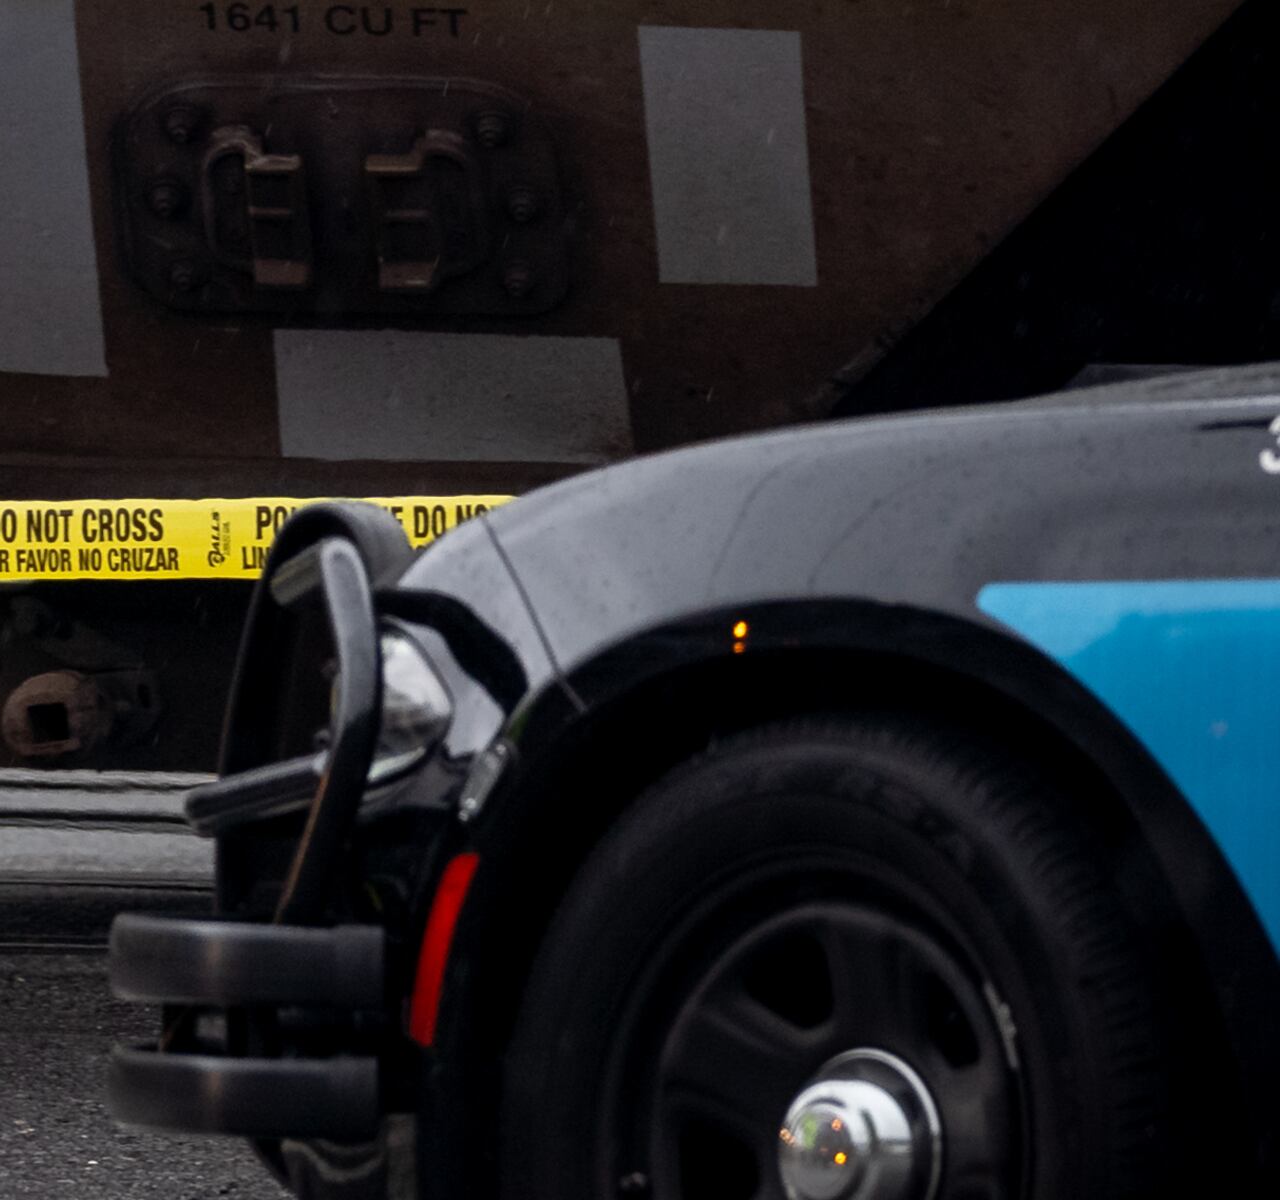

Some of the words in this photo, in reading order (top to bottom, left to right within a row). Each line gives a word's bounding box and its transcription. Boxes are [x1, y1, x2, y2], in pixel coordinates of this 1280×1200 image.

[199, 2, 301, 33] 1641
[324, 5, 393, 35] CU
[412, 8, 468, 37] FT
[26, 508, 74, 544] NOT
[81, 507, 164, 544] CROSS
[414, 505, 446, 538] DO
[15, 548, 72, 573] FAVOR
[78, 547, 102, 572] NO
[107, 547, 180, 572] CRUZAR
